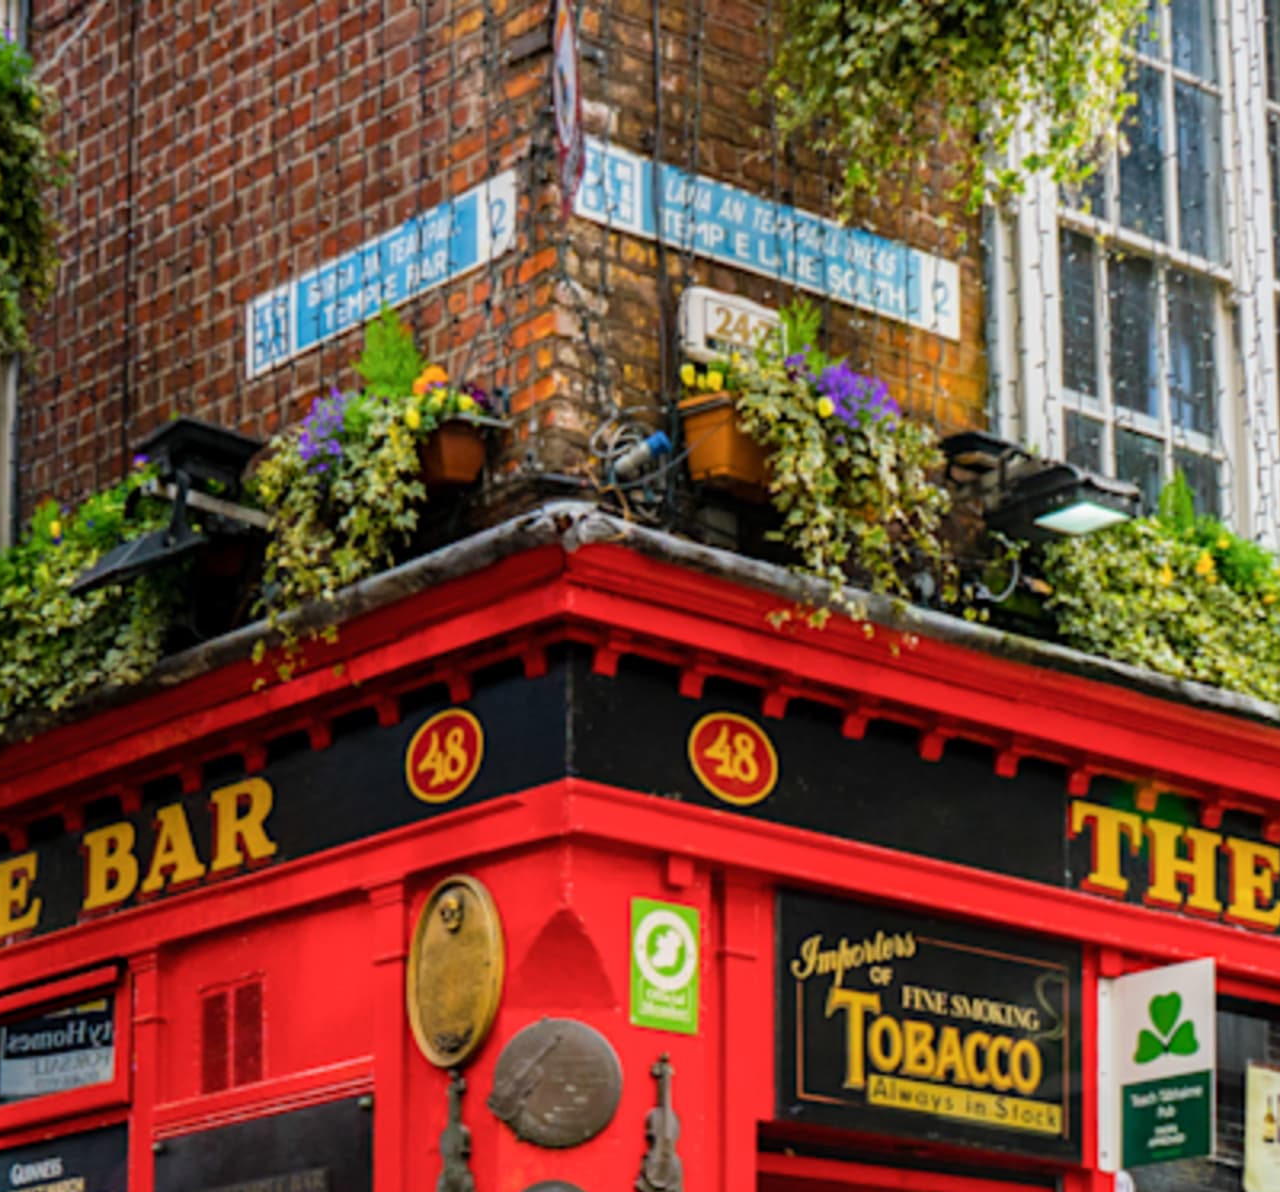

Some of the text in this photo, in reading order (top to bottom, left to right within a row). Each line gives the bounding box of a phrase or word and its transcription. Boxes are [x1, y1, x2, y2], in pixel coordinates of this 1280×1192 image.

[488, 197, 508, 237] 2
[663, 209, 750, 258] TEMPE
[720, 195, 745, 223] AN
[418, 726, 468, 788] 48
[706, 724, 760, 785] 48
[80, 776, 280, 914] BAR
[790, 930, 916, 988] Importers
[869, 965, 893, 986] OF
[901, 985, 1041, 1032] FINE SMOKING
[825, 986, 1043, 1095] TOBACCO
[872, 1077, 1058, 1128] Always in Stock
[9, 1157, 63, 1186] GUINNESS
